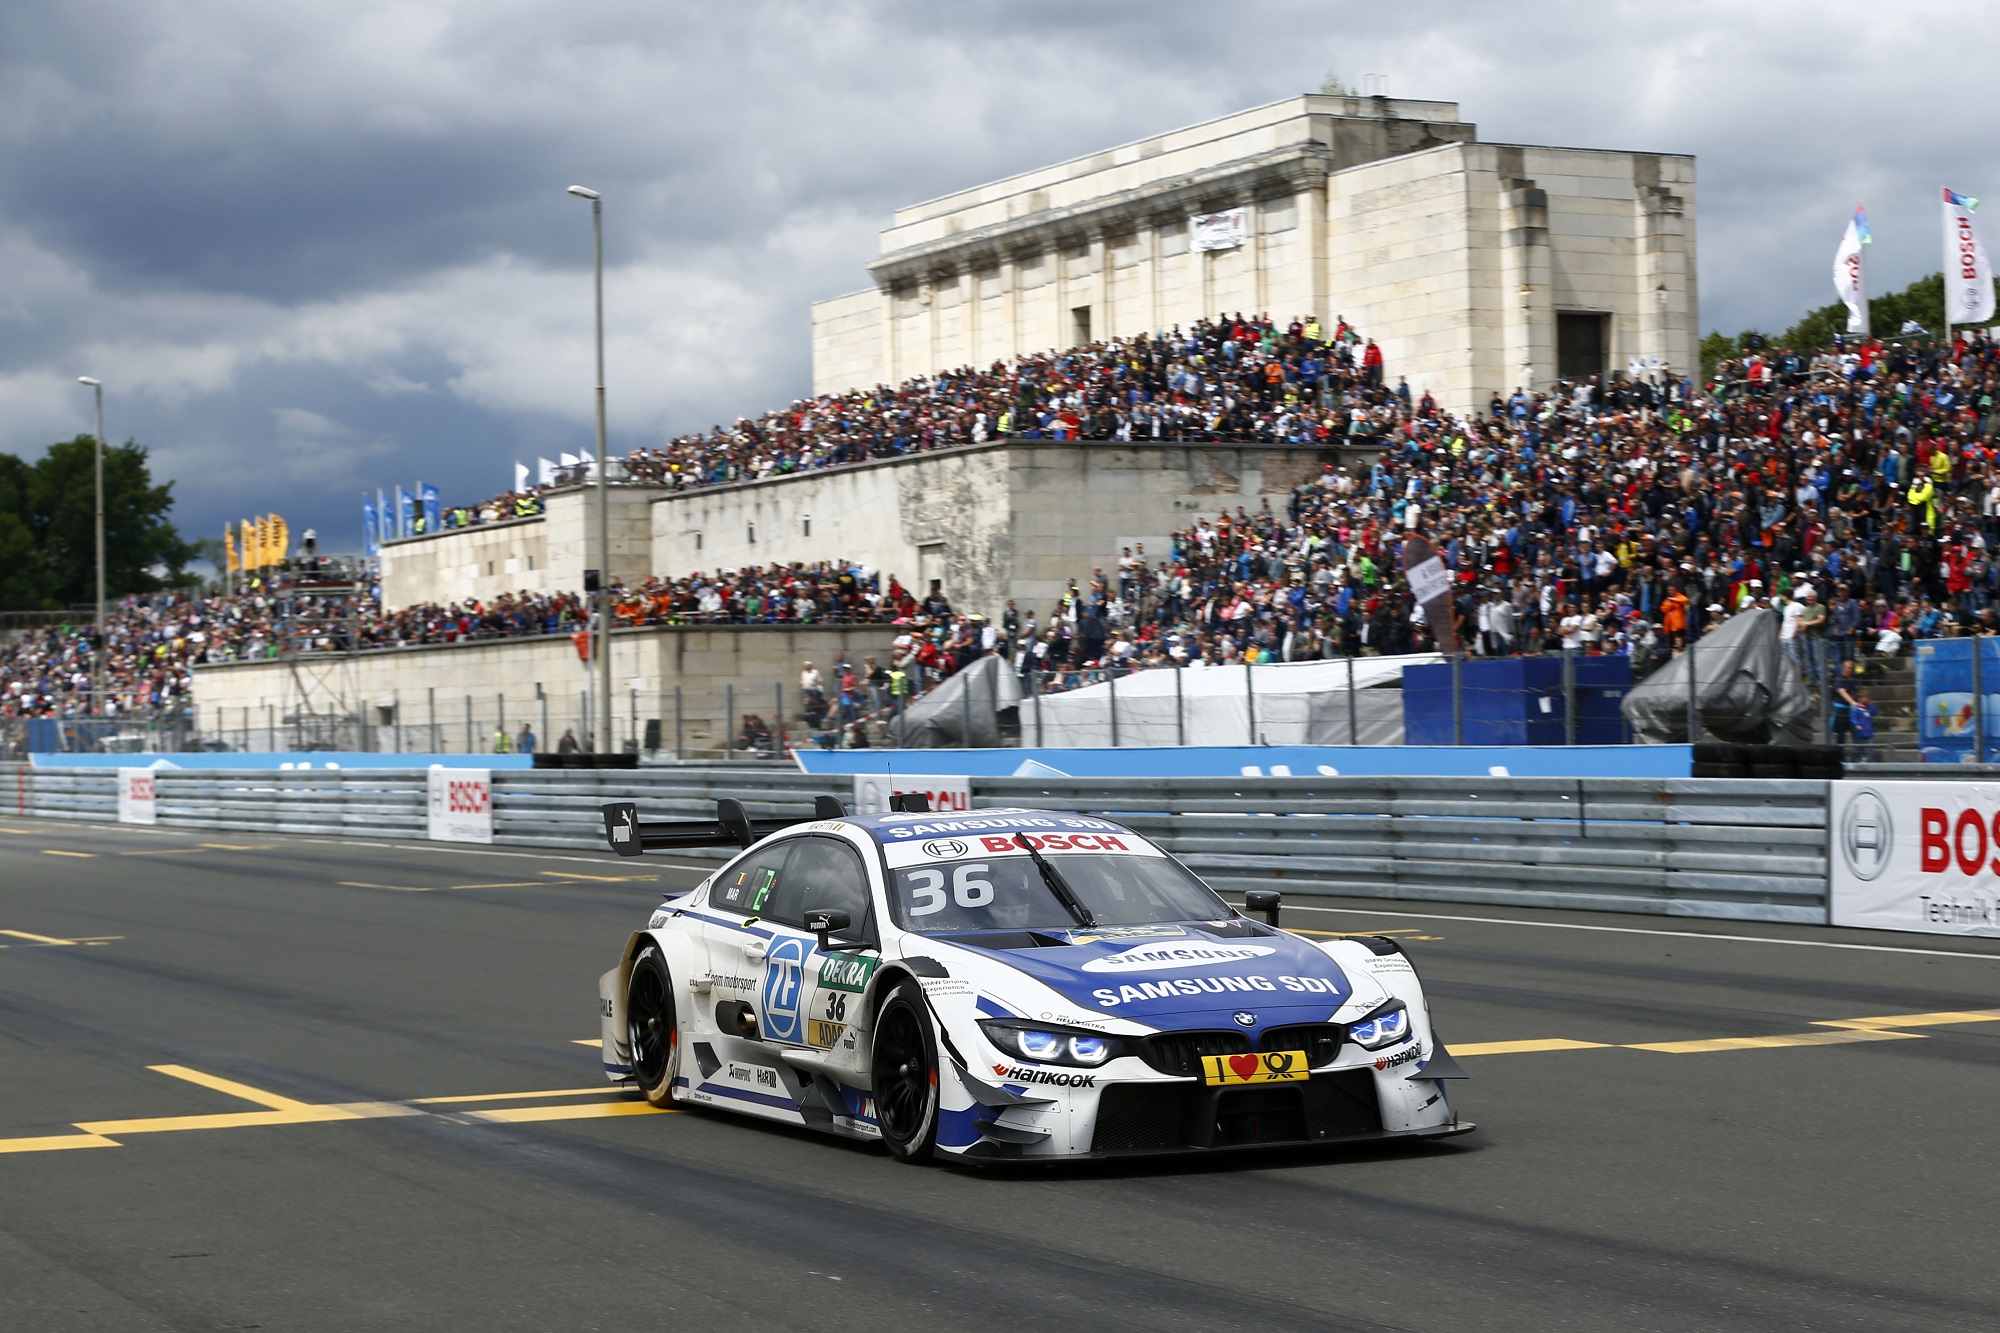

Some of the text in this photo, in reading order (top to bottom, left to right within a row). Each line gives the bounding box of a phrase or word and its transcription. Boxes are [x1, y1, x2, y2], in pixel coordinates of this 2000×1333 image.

[1957, 216, 1977, 279] BOSCH
[888, 818, 1116, 838] SAMSUNG SDI
[979, 834, 1131, 853] BOSCH
[725, 887, 741, 901] MAR
[906, 864, 994, 917] 36
[1919, 895, 1991, 923] Technik
[1102, 947, 1260, 965] SAMSUNG
[823, 958, 868, 987] DEKRA
[769, 957, 802, 1018] ZF
[1092, 975, 1340, 1007] SAMSUNG SDI
[826, 992, 847, 1021] 36
